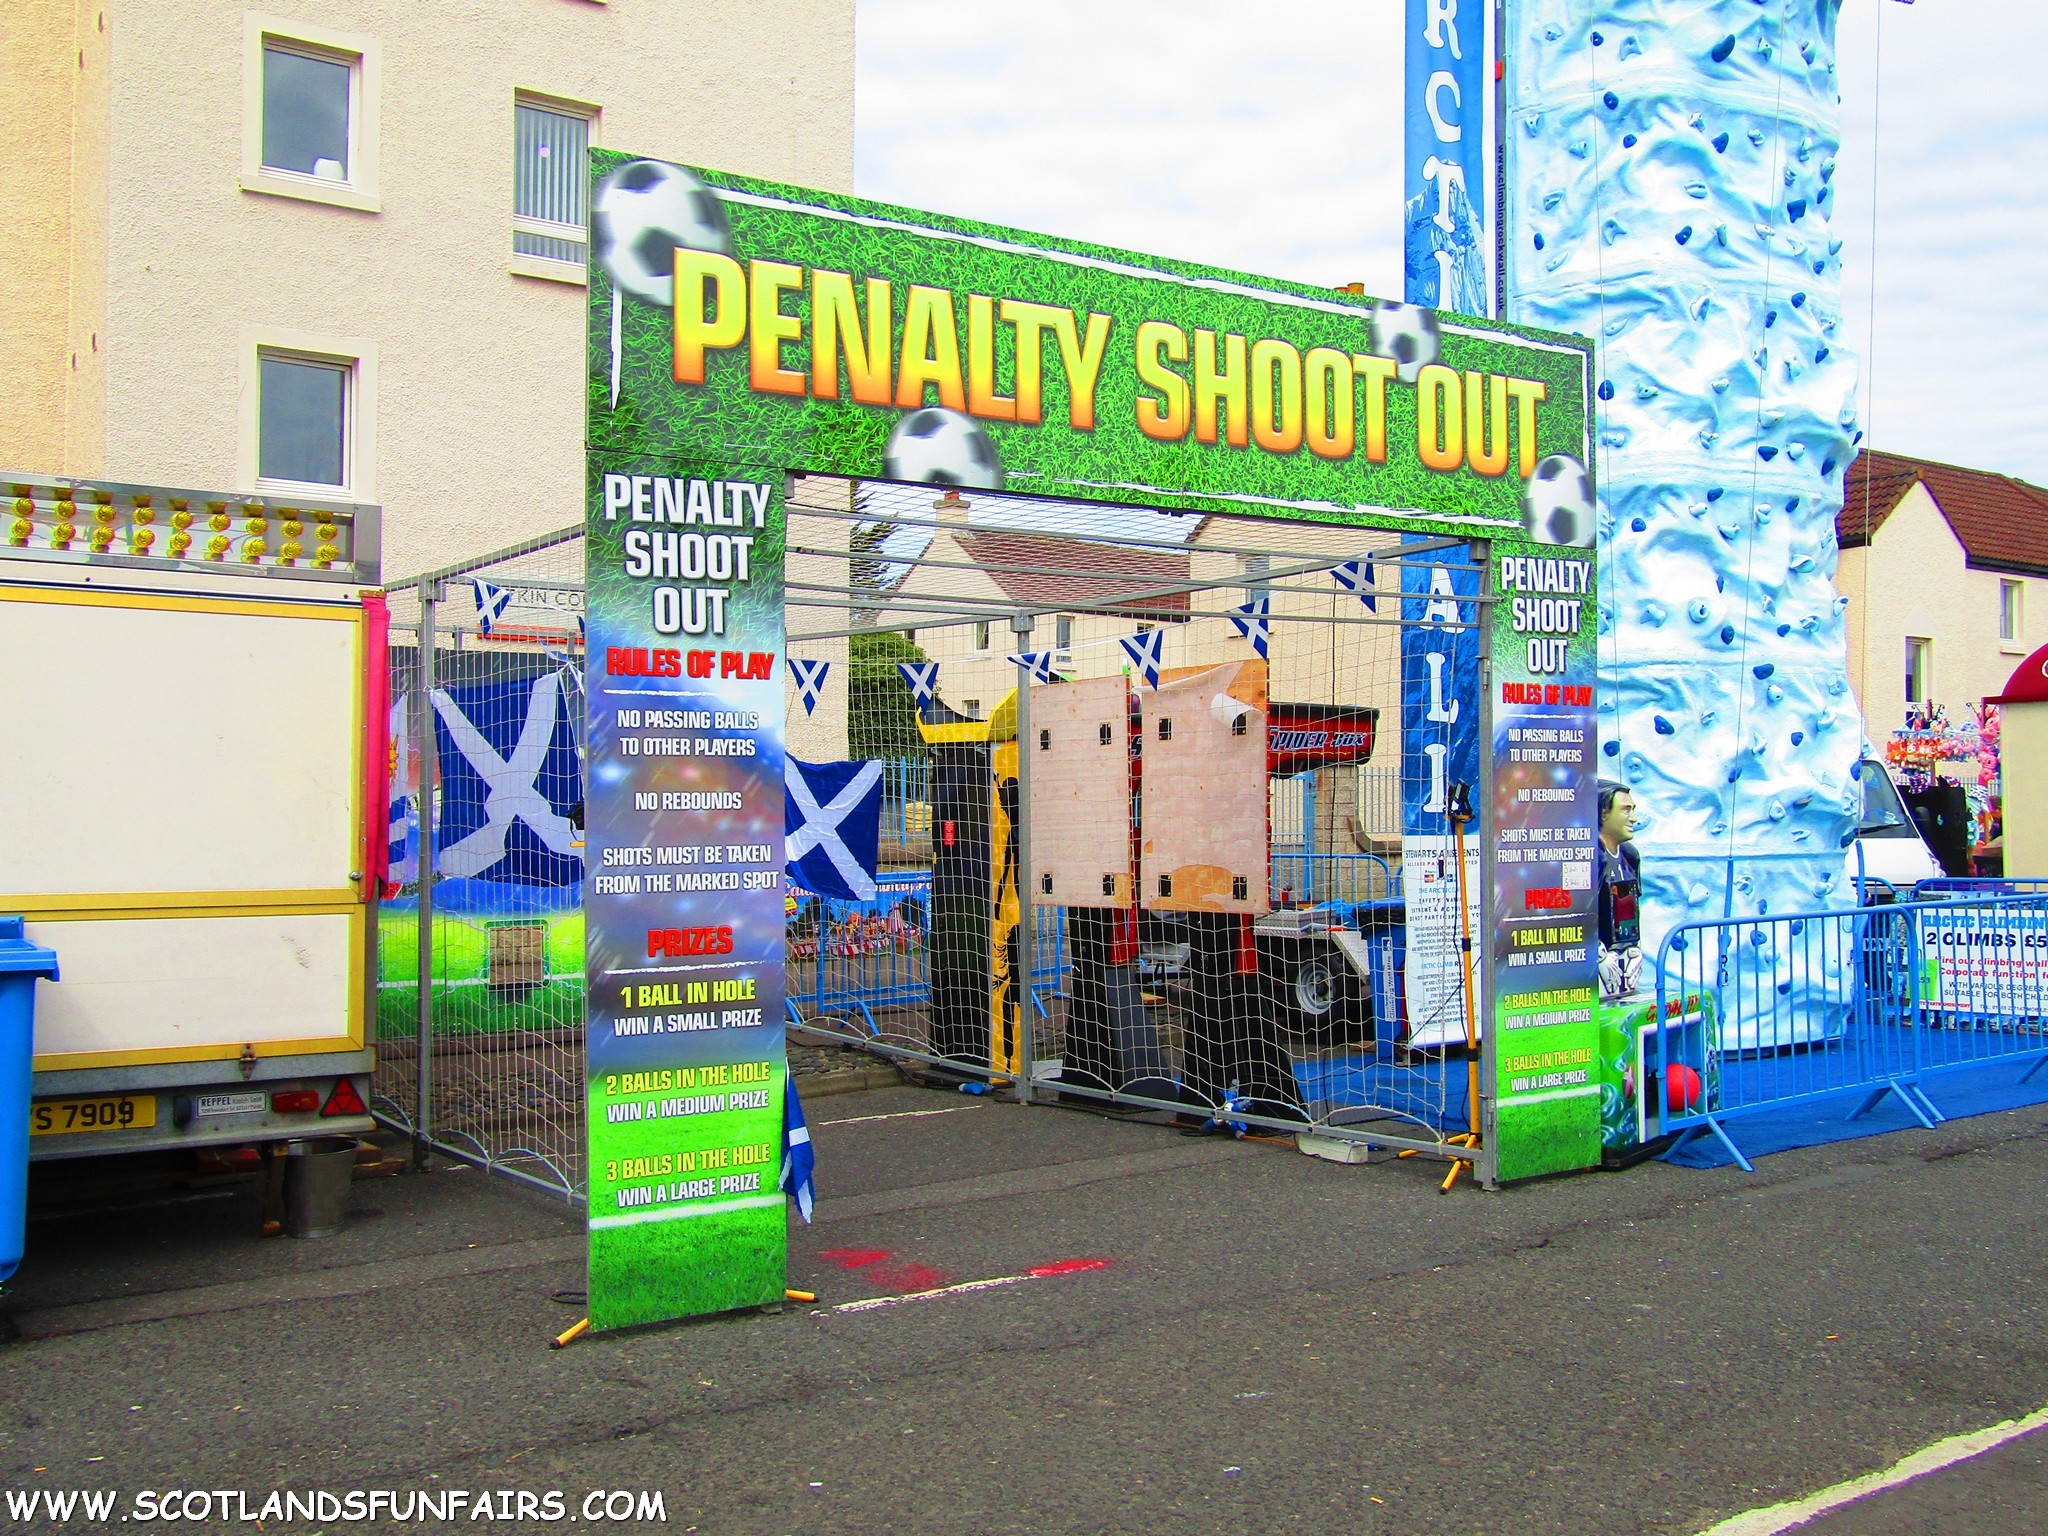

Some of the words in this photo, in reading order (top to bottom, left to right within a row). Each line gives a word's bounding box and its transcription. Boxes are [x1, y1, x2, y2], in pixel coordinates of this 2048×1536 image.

[673, 246, 1112, 430] PENALTY
[1136, 320, 1397, 464] SHOOT
[1417, 363, 1546, 479] OUT
[604, 473, 771, 528] PENALTY
[625, 530, 753, 580] SHOOT
[1501, 557, 1591, 594] PENALTY
[555, 592, 585, 606] CO
[653, 586, 730, 634] OUT
[1512, 598, 1581, 633] SHOOT
[607, 647, 681, 677] RULES
[687, 650, 715, 678] OF
[721, 652, 775, 679] PLAY
[1527, 638, 1567, 673] OUT
[1502, 682, 1542, 704] RULES
[1545, 684, 1560, 705] OF
[1563, 685, 1592, 706] PLAY
[617, 710, 640, 728] NO
[645, 711, 710, 729] PASSING
[714, 713, 759, 730] BALLS
[1509, 729, 1520, 741] NO
[1523, 729, 1557, 742] PASSING
[1560, 730, 1583, 742] BALLS
[620, 738, 638, 755] TO
[643, 738, 690, 756] OTHER
[695, 739, 755, 756] PLAYERS
[1510, 749, 1520, 761] TO
[1522, 749, 1547, 761] OTHER
[1550, 750, 1582, 762] PLAYERS
[635, 793, 658, 810] NO
[662, 792, 742, 810] REBOUNDS
[1518, 789, 1530, 801] NO
[1532, 789, 1575, 801] REBOUNDS
[1502, 830, 1527, 842] SHOTS
[1530, 829, 1552, 841] MUST
[1555, 828, 1564, 840] BE
[1566, 828, 1590, 840] TAKEN
[603, 848, 652, 866] SHOTS
[657, 847, 700, 865] MUST
[705, 846, 722, 863] BE
[726, 845, 771, 862] TAKEN
[1498, 850, 1521, 862] FROM
[1523, 849, 1537, 861] THE
[1540, 848, 1573, 861] MARKED
[1576, 848, 1594, 860] SPOT
[596, 876, 640, 894] FROM
[645, 875, 671, 892] THE
[676, 872, 739, 891] MARKED
[743, 872, 779, 889] SPOT
[1525, 888, 1572, 910] PRIZES
[648, 926, 734, 957] PRIZES
[1511, 930, 1518, 946] 1
[1521, 928, 1543, 946] BALL
[1547, 928, 1557, 944] IN
[1560, 926, 1583, 943] HOLE
[1926, 932, 1937, 944] 2
[1942, 933, 2017, 947] CLIMBS
[1508, 953, 1526, 967] WIN
[1528, 952, 1534, 965] A
[1536, 950, 1562, 964] SMALL
[1565, 949, 1586, 962] PRIZE
[620, 987, 631, 1007] 1
[638, 983, 682, 1007] BALL
[687, 982, 708, 1004] IN
[713, 979, 756, 1002] HOLE
[1505, 995, 1510, 1009] 2
[1512, 992, 1538, 1009] BALLS
[1540, 991, 1550, 1005] IN
[1552, 990, 1568, 1004] THE
[1570, 988, 1591, 1003] HOLE
[614, 1017, 648, 1036] WIN
[653, 1016, 664, 1033] A
[668, 1012, 718, 1032] SMALL
[722, 1009, 762, 1027] PRIZE
[1505, 1016, 1524, 1030] WIN
[1525, 1015, 1531, 1028] A
[1533, 1011, 1567, 1027] MEDIUM
[1569, 1009, 1590, 1023] PRIZE
[1505, 1058, 1511, 1072] 3
[1513, 1055, 1539, 1071] BALLS
[1542, 1053, 1551, 1067] IN
[1553, 1052, 1569, 1066] THE
[1571, 1048, 1592, 1064] HOLE
[606, 1076, 617, 1094] 2
[622, 1071, 672, 1093] BALLS
[677, 1069, 695, 1089] IN
[699, 1066, 728, 1087] THE
[732, 1062, 770, 1084] HOLE
[1511, 1077, 1529, 1091] WIN
[1531, 1076, 1537, 1089] A
[1538, 1073, 1563, 1088] LARGE
[1565, 1070, 1586, 1084] PRIZE
[201, 1097, 230, 1106] REPPEL
[607, 1103, 642, 1123] WIN
[646, 1102, 657, 1119] A
[661, 1094, 725, 1117] MEDIUM
[729, 1090, 769, 1110] PRIZE
[62, 1101, 134, 1128] 7909
[606, 1162, 617, 1180] 3
[622, 1155, 672, 1179] BALLS
[677, 1152, 695, 1172] IN
[700, 1149, 728, 1169] THE
[732, 1144, 770, 1164] HOLE
[617, 1186, 652, 1207] WIN
[656, 1185, 667, 1202] A
[671, 1179, 716, 1200] LARGE
[720, 1173, 760, 1193] PRIZE
